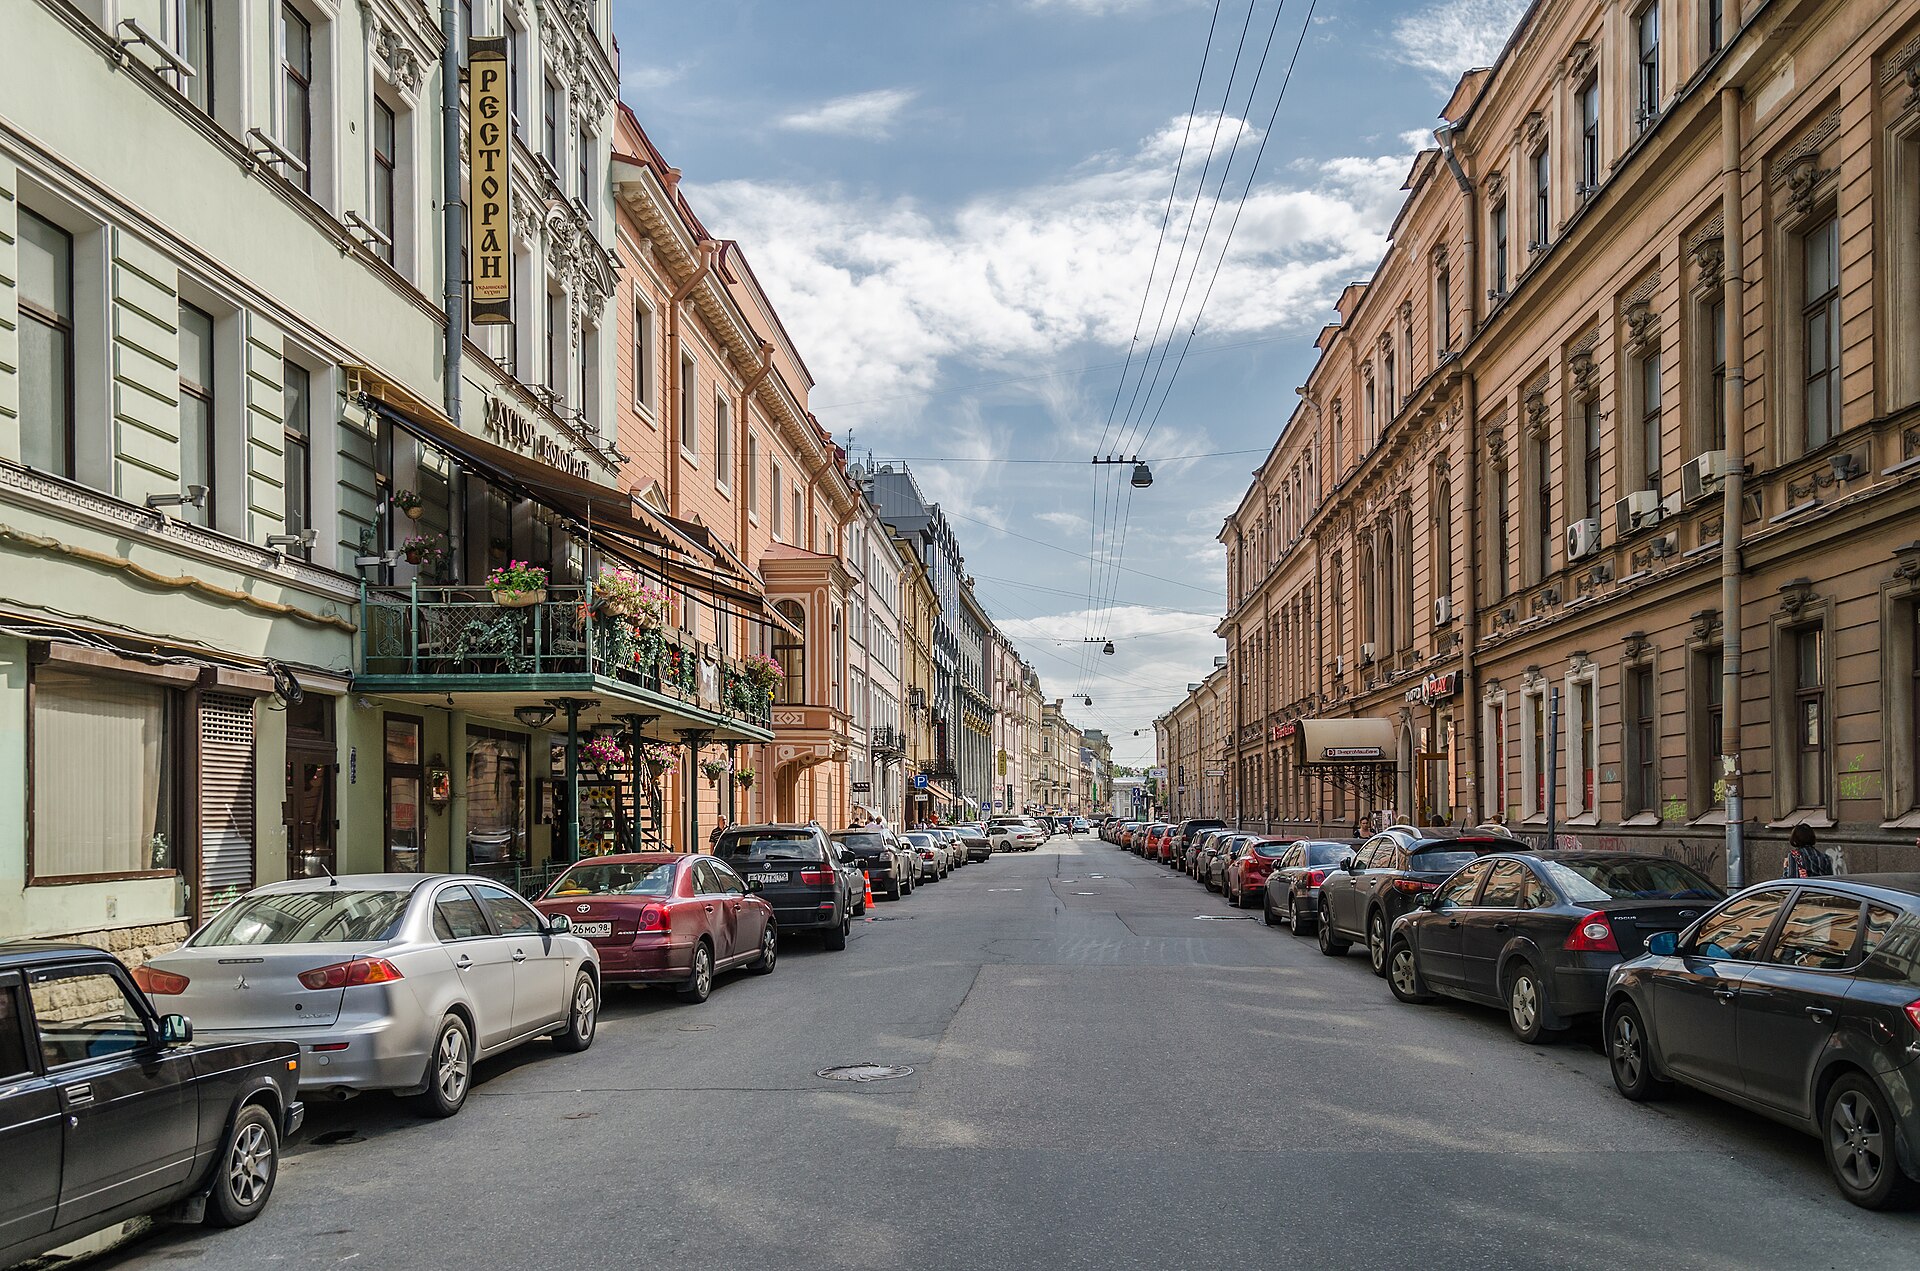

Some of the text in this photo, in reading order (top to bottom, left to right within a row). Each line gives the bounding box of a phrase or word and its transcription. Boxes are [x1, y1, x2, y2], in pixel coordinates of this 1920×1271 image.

[479, 69, 502, 278] РЕСТОРАН
[1429, 677, 1447, 697] PLAY
[917, 776, 925, 786] P
